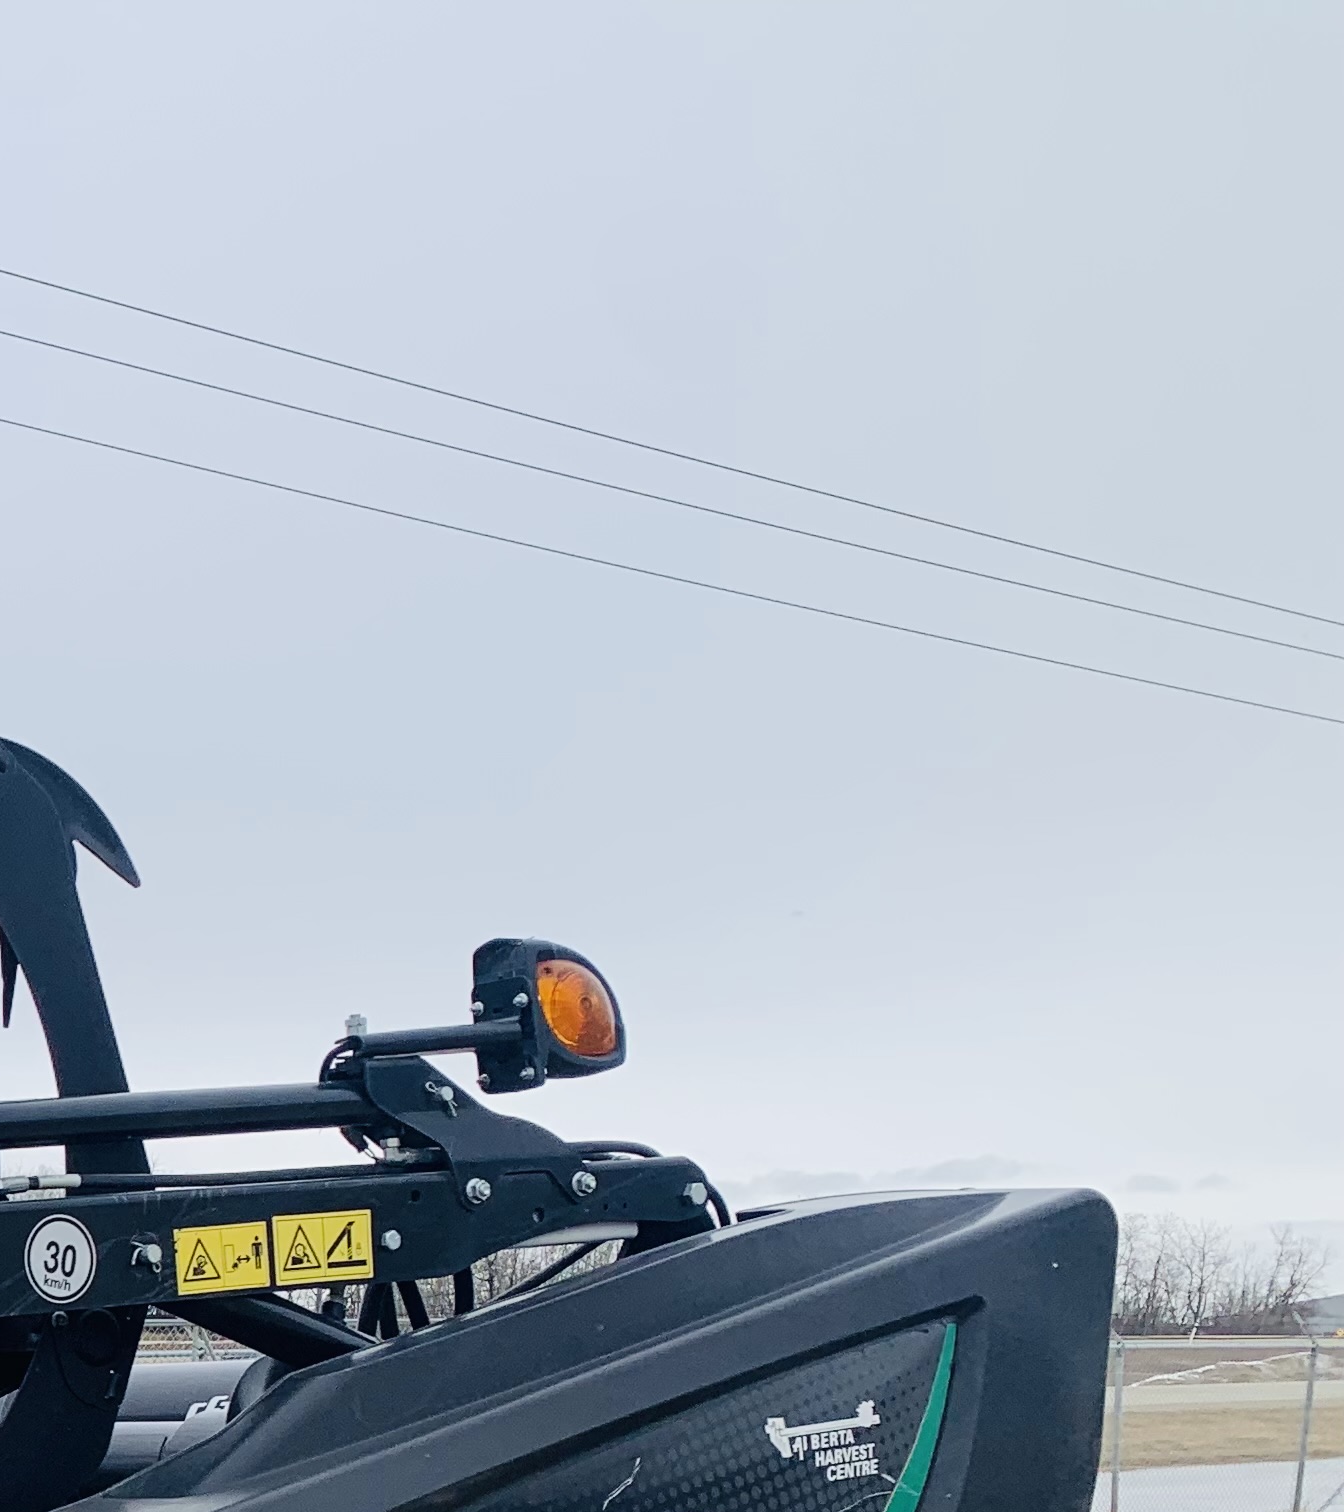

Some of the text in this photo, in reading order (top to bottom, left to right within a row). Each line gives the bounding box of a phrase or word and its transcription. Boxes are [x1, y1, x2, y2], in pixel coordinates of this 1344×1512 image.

[43, 1240, 77, 1278] 30
[43, 1274, 72, 1292] km/h
[814, 1442, 876, 1468] HARVEST
[826, 1458, 880, 1482] CENTRE
